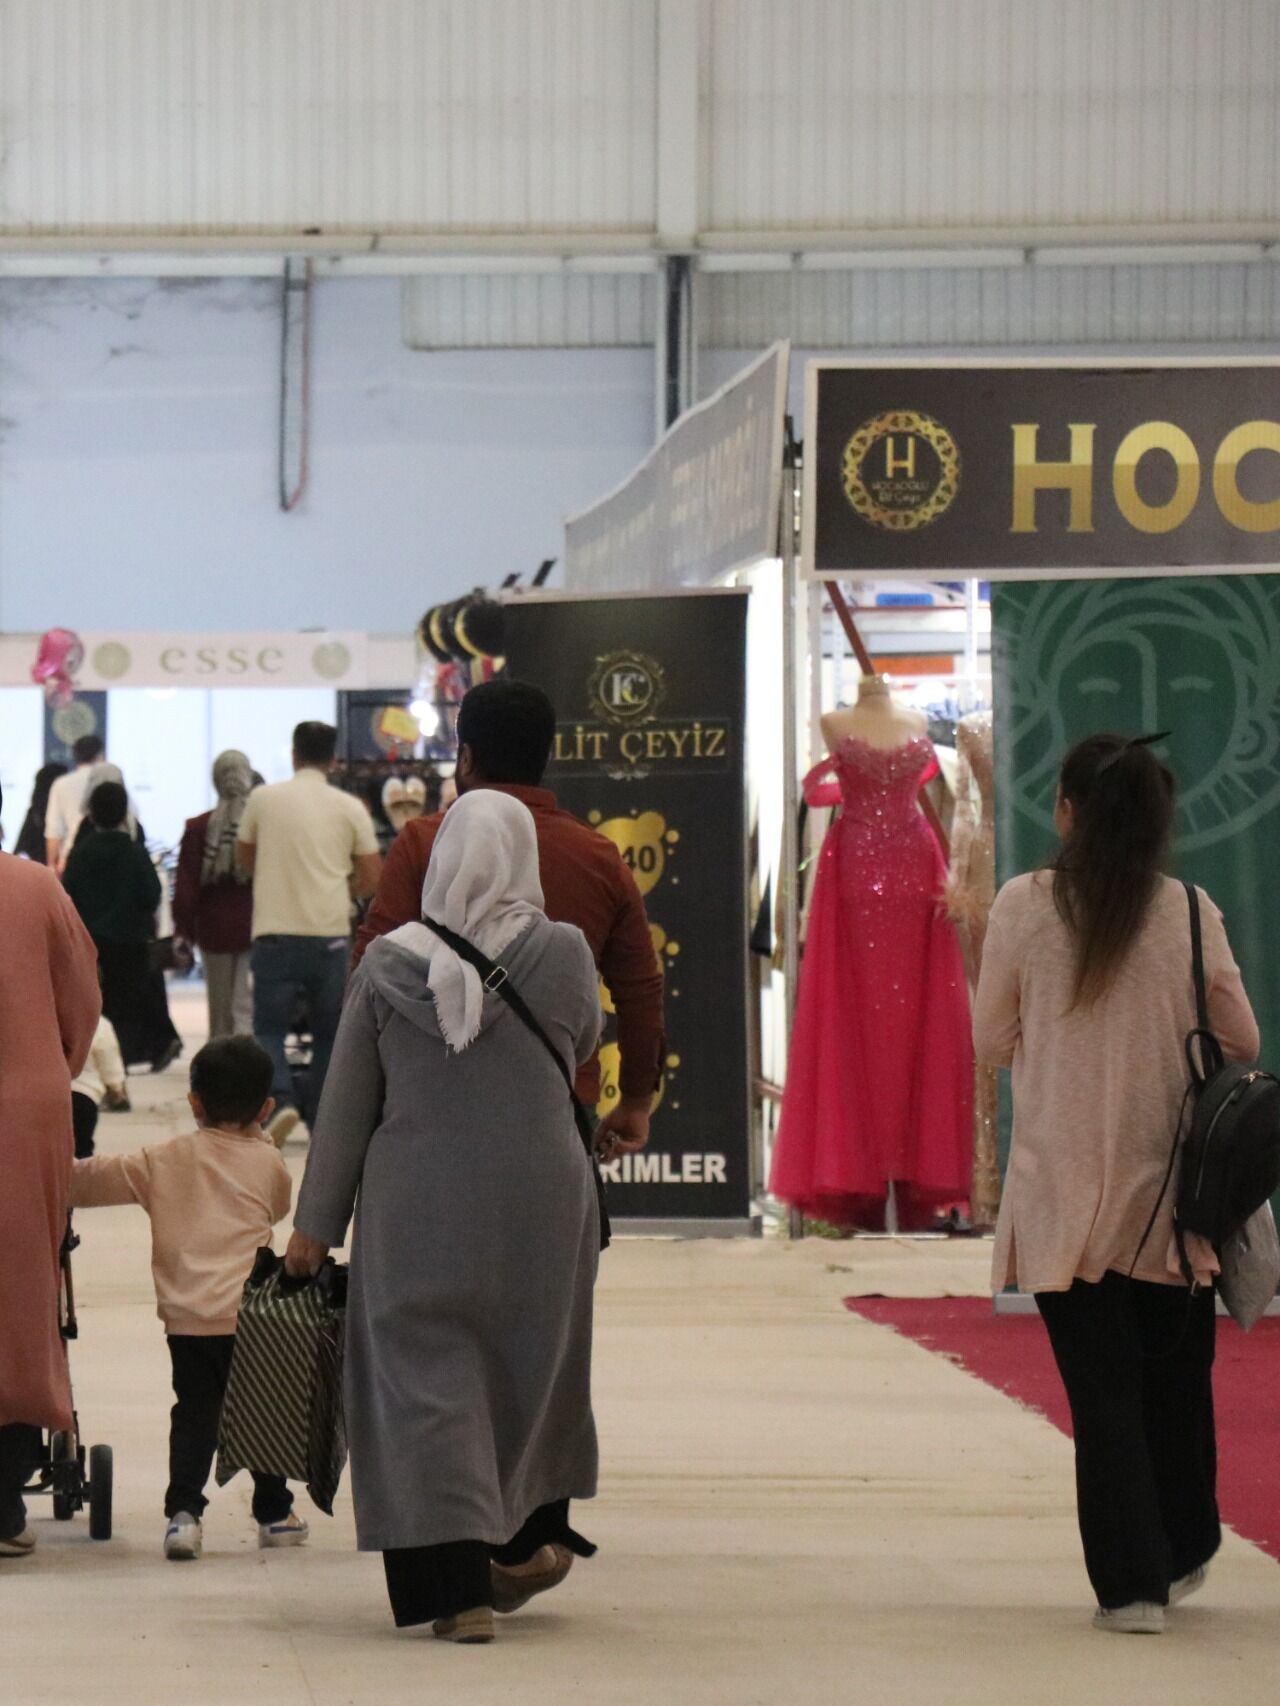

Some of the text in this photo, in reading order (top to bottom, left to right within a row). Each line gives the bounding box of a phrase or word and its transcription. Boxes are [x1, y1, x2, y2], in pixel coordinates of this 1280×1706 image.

[886, 436, 915, 479] H
[553, 722, 726, 764] LİT ÇEYİZ
[598, 1153, 727, 1183] RIMLER
